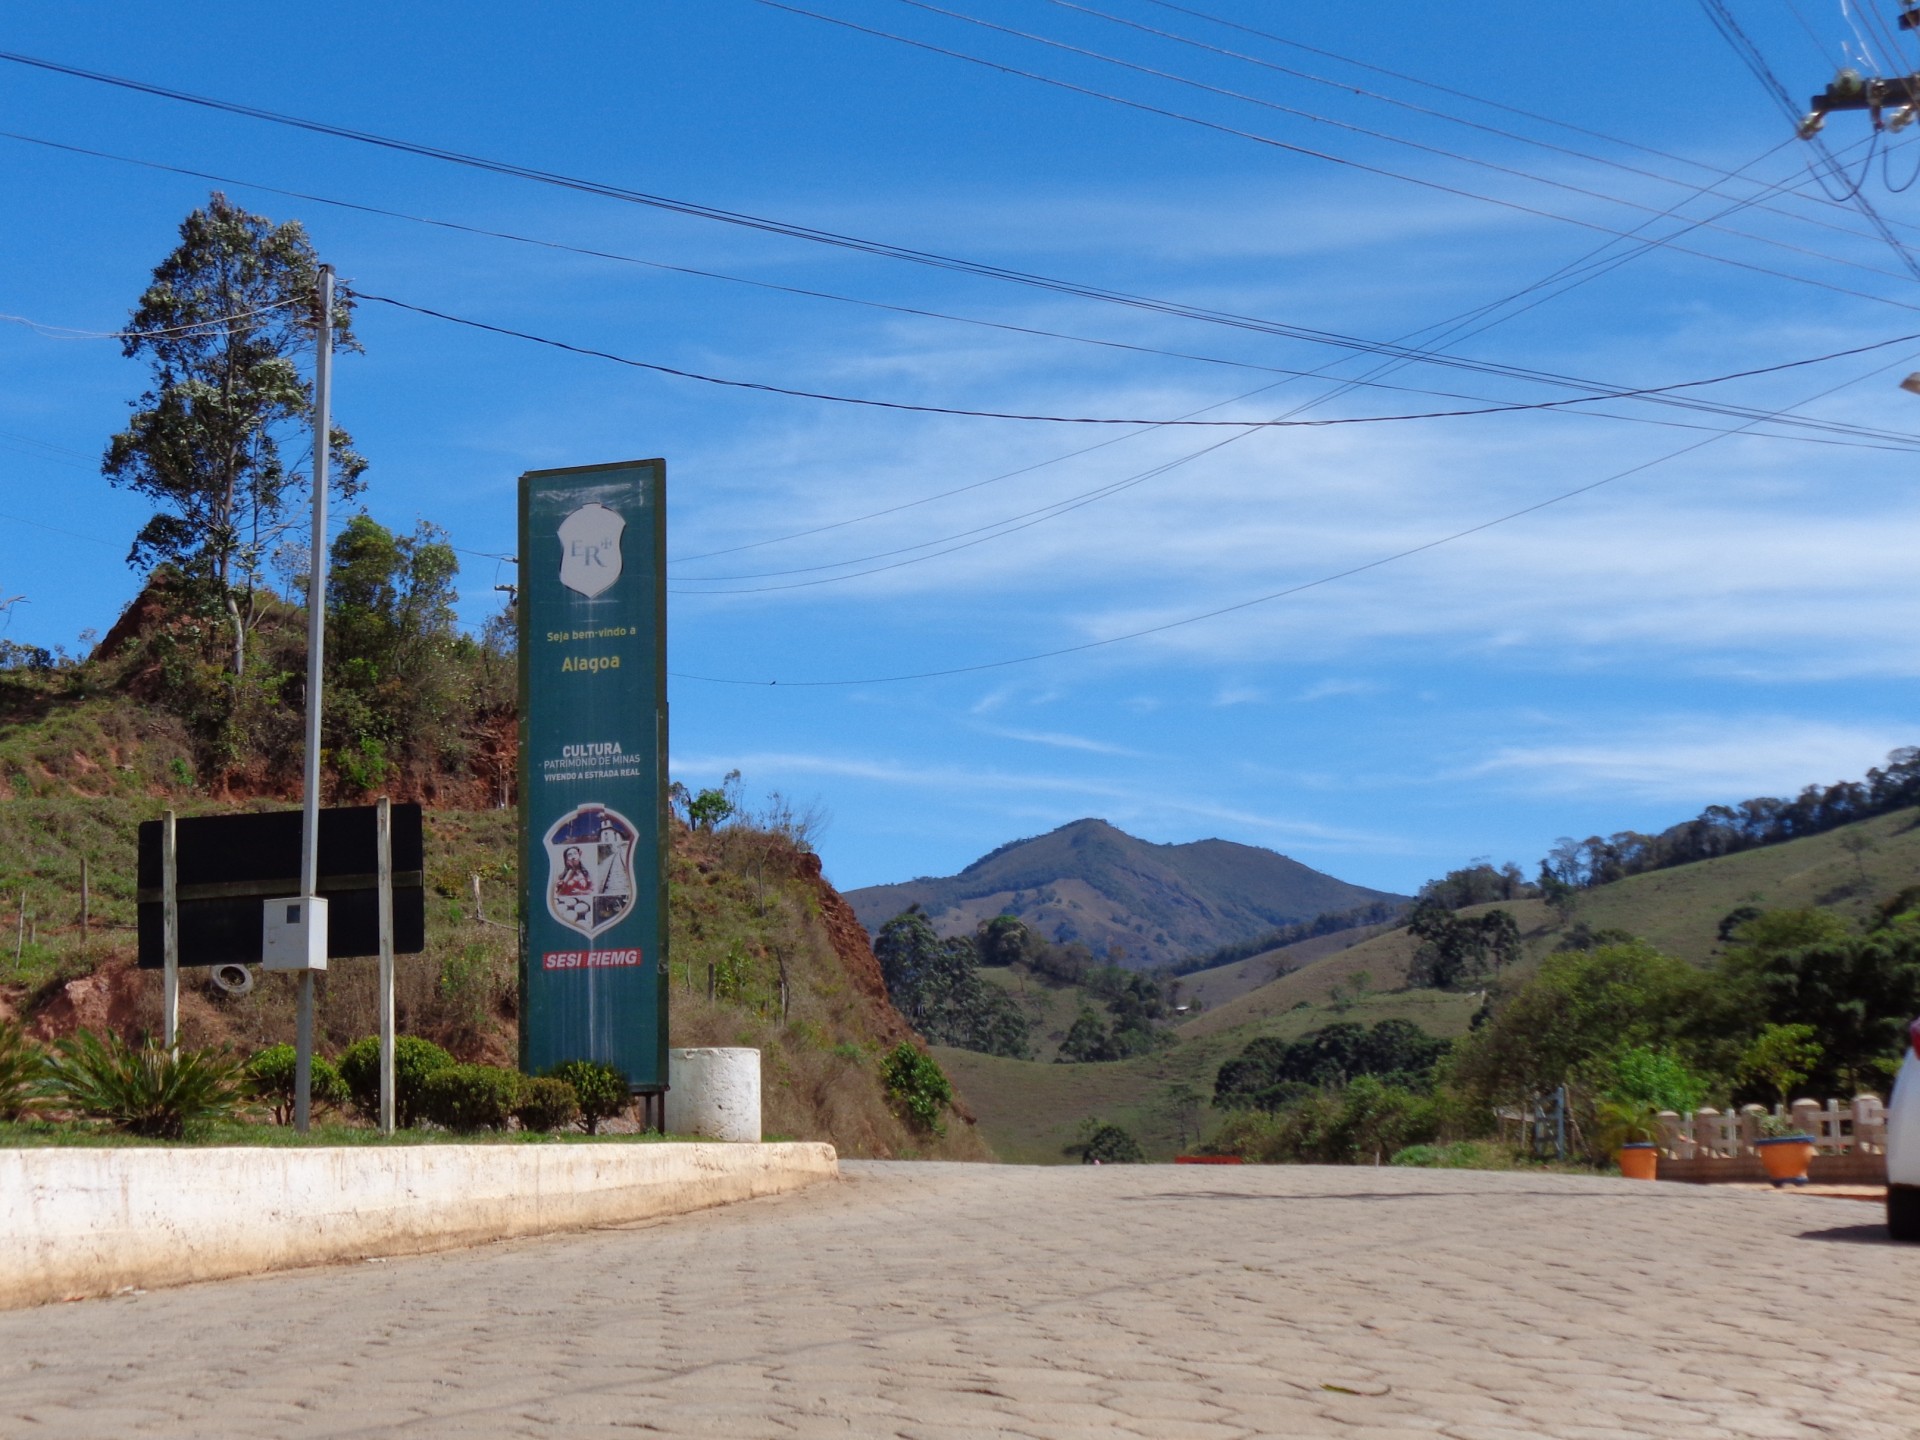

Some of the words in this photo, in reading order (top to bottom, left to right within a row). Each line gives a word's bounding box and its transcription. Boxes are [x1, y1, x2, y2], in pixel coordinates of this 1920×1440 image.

[547, 631, 569, 643] Seja
[630, 627, 636, 635] a
[562, 656, 620, 674] Alagoa
[562, 742, 622, 758] CULTURA
[598, 756, 610, 766] DE
[612, 754, 640, 764] MINAS
[544, 772, 576, 782] VIVENDO
[578, 772, 584, 780] A
[584, 769, 619, 780] ESTRADA
[620, 768, 640, 777] REAL
[546, 953, 582, 968] SESI
[587, 950, 638, 966] FIEMG
